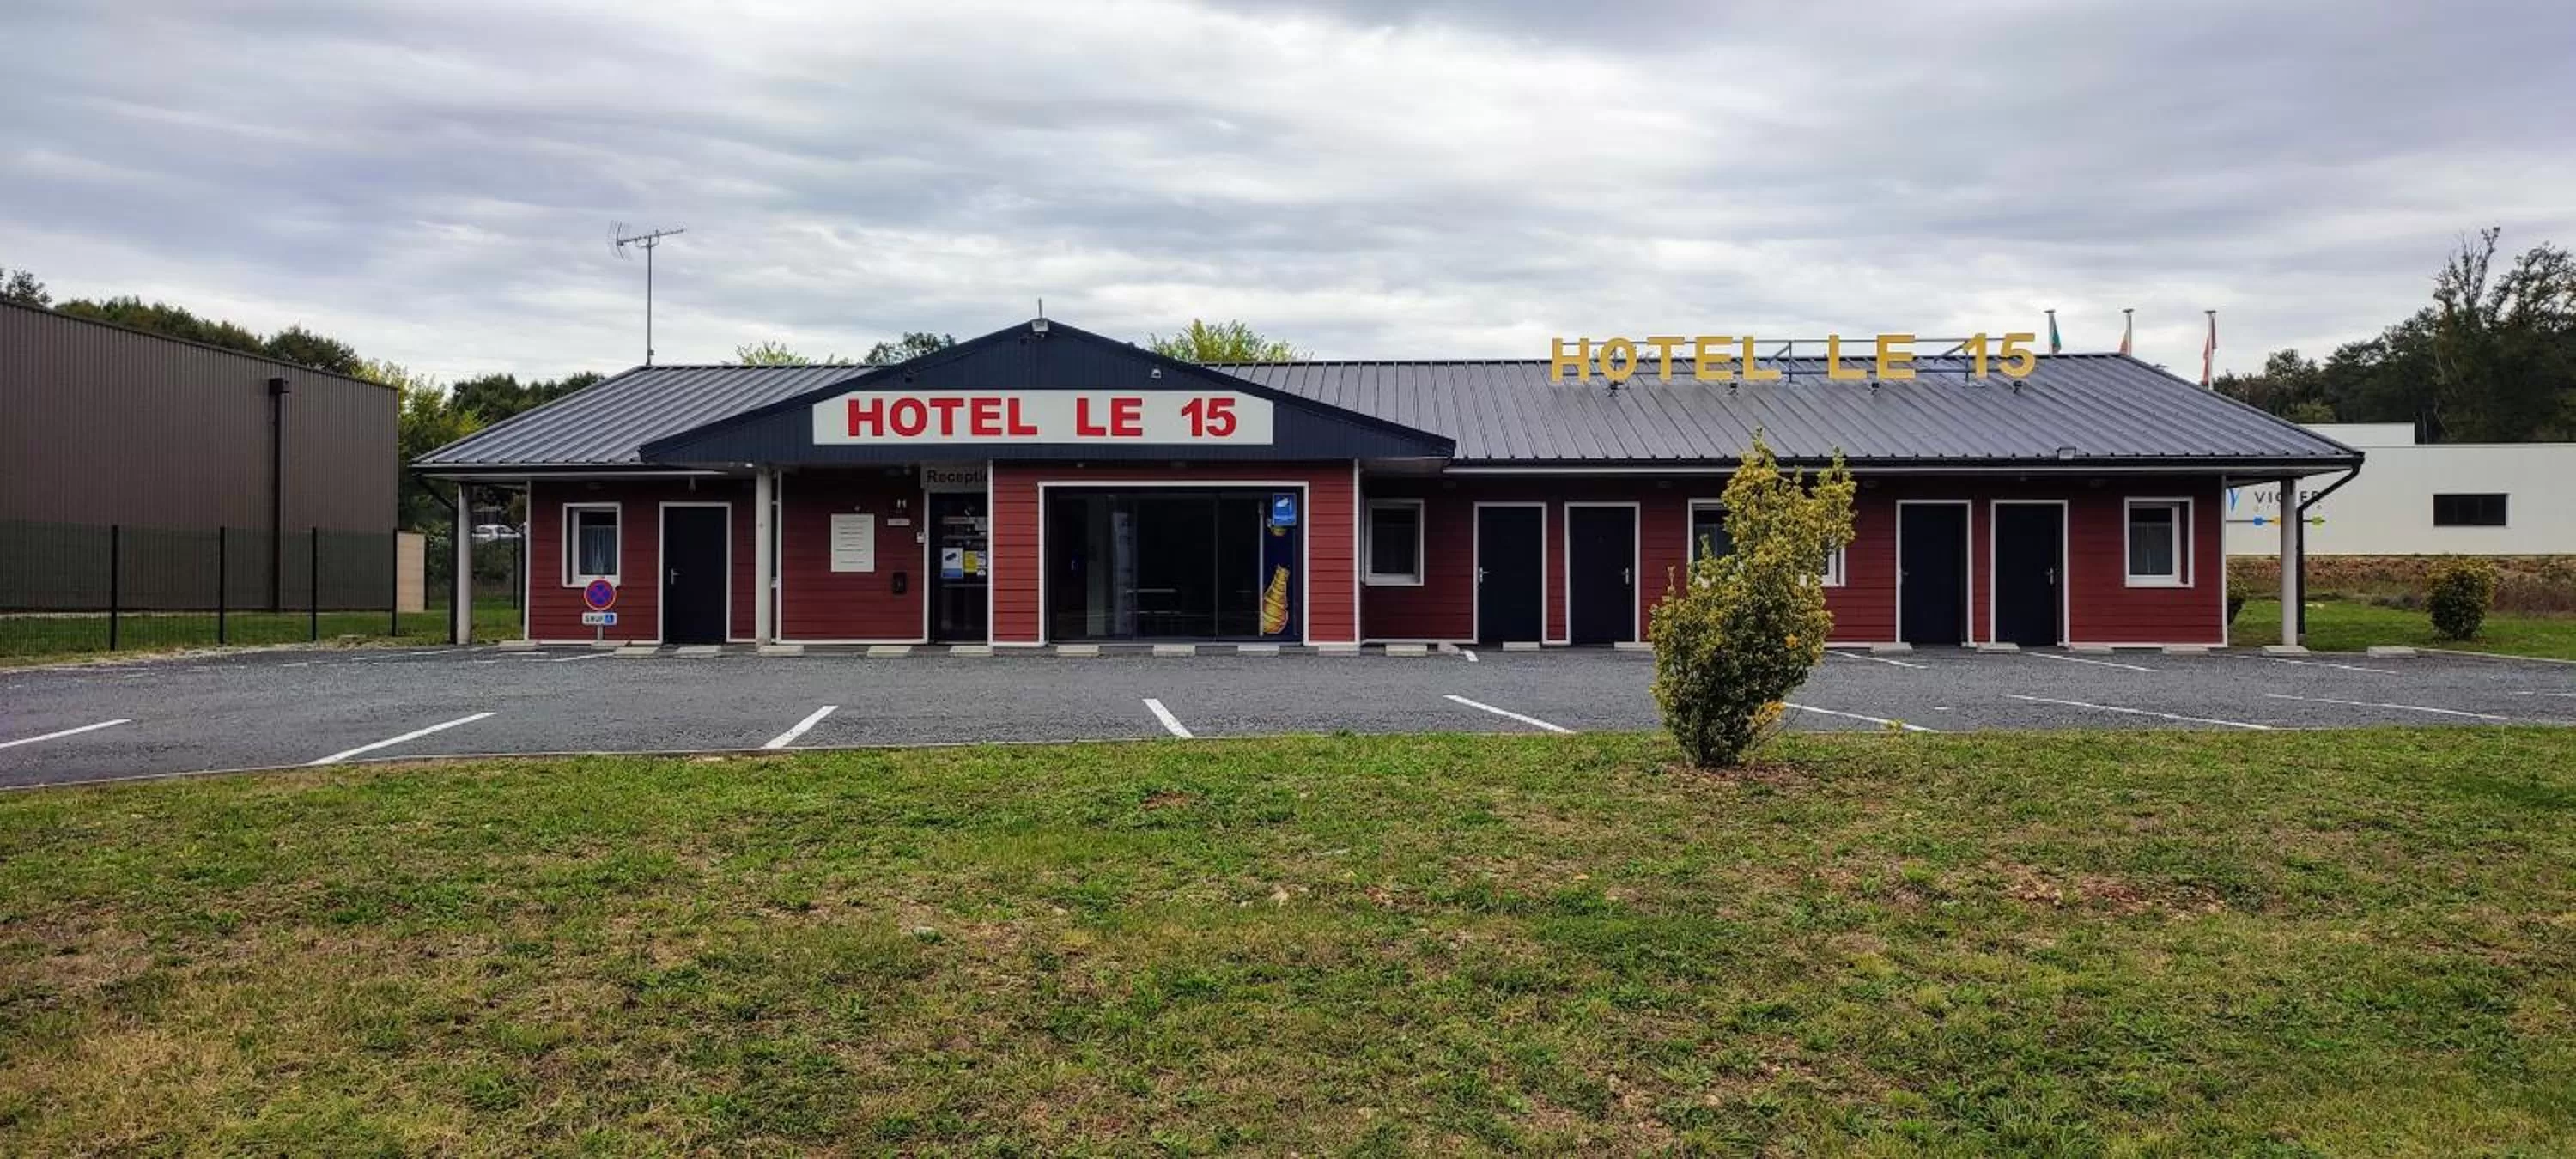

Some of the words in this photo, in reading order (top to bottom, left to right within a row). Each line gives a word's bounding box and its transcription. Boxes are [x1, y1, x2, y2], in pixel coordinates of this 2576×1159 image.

[1551, 336, 1782, 382] HOTEL
[1828, 334, 1916, 380] LE
[1964, 332, 2036, 379] 15
[848, 397, 1038, 437] HOTEL
[1076, 397, 1143, 437] LE
[1180, 397, 1237, 437] 15
[927, 469, 987, 487] Recepti
